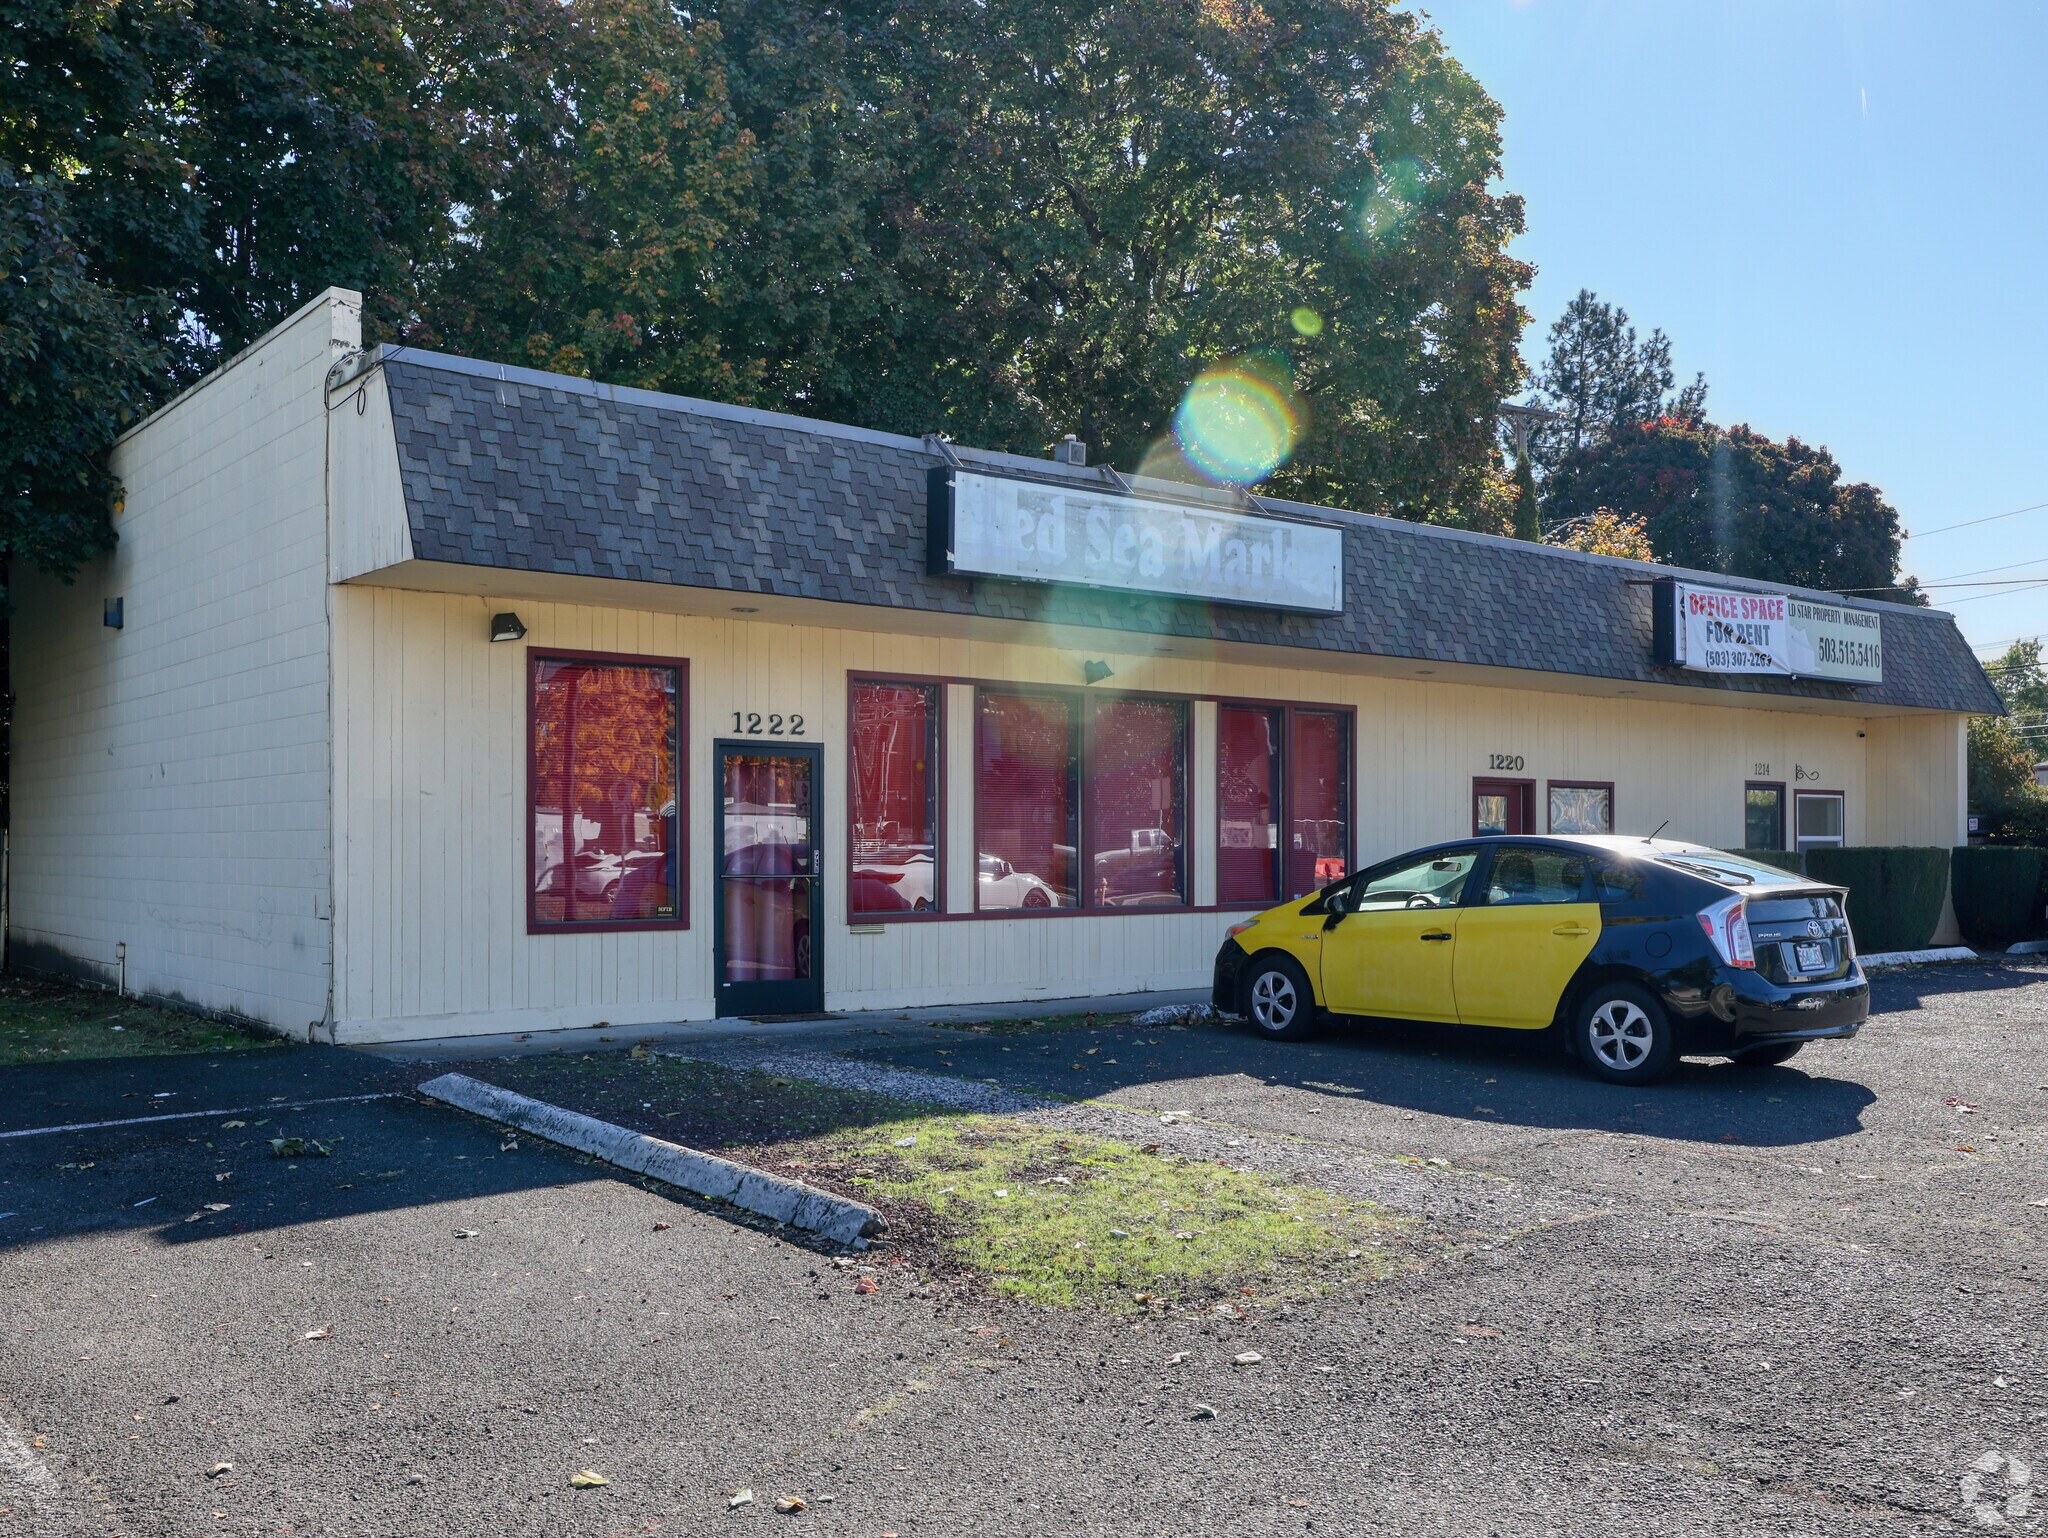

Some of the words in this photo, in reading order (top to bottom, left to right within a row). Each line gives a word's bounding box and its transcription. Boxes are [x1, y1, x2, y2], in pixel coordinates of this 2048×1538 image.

[1084, 503, 1166, 579] Sea
[1689, 593, 1738, 618] OFFICE
[1741, 597, 1784, 620] SPACE
[1797, 604, 1812, 619] STAR
[1812, 607, 1841, 624] PROPERTY
[1843, 611, 1878, 630] MANAGEMENT
[1706, 620, 1734, 643] FOR
[1736, 623, 1770, 646] RENT
[1819, 637, 1880, 669] 503.515.5416
[731, 711, 805, 736] 1222
[1488, 754, 1525, 771] 1220
[1754, 762, 1770, 776] 1214
